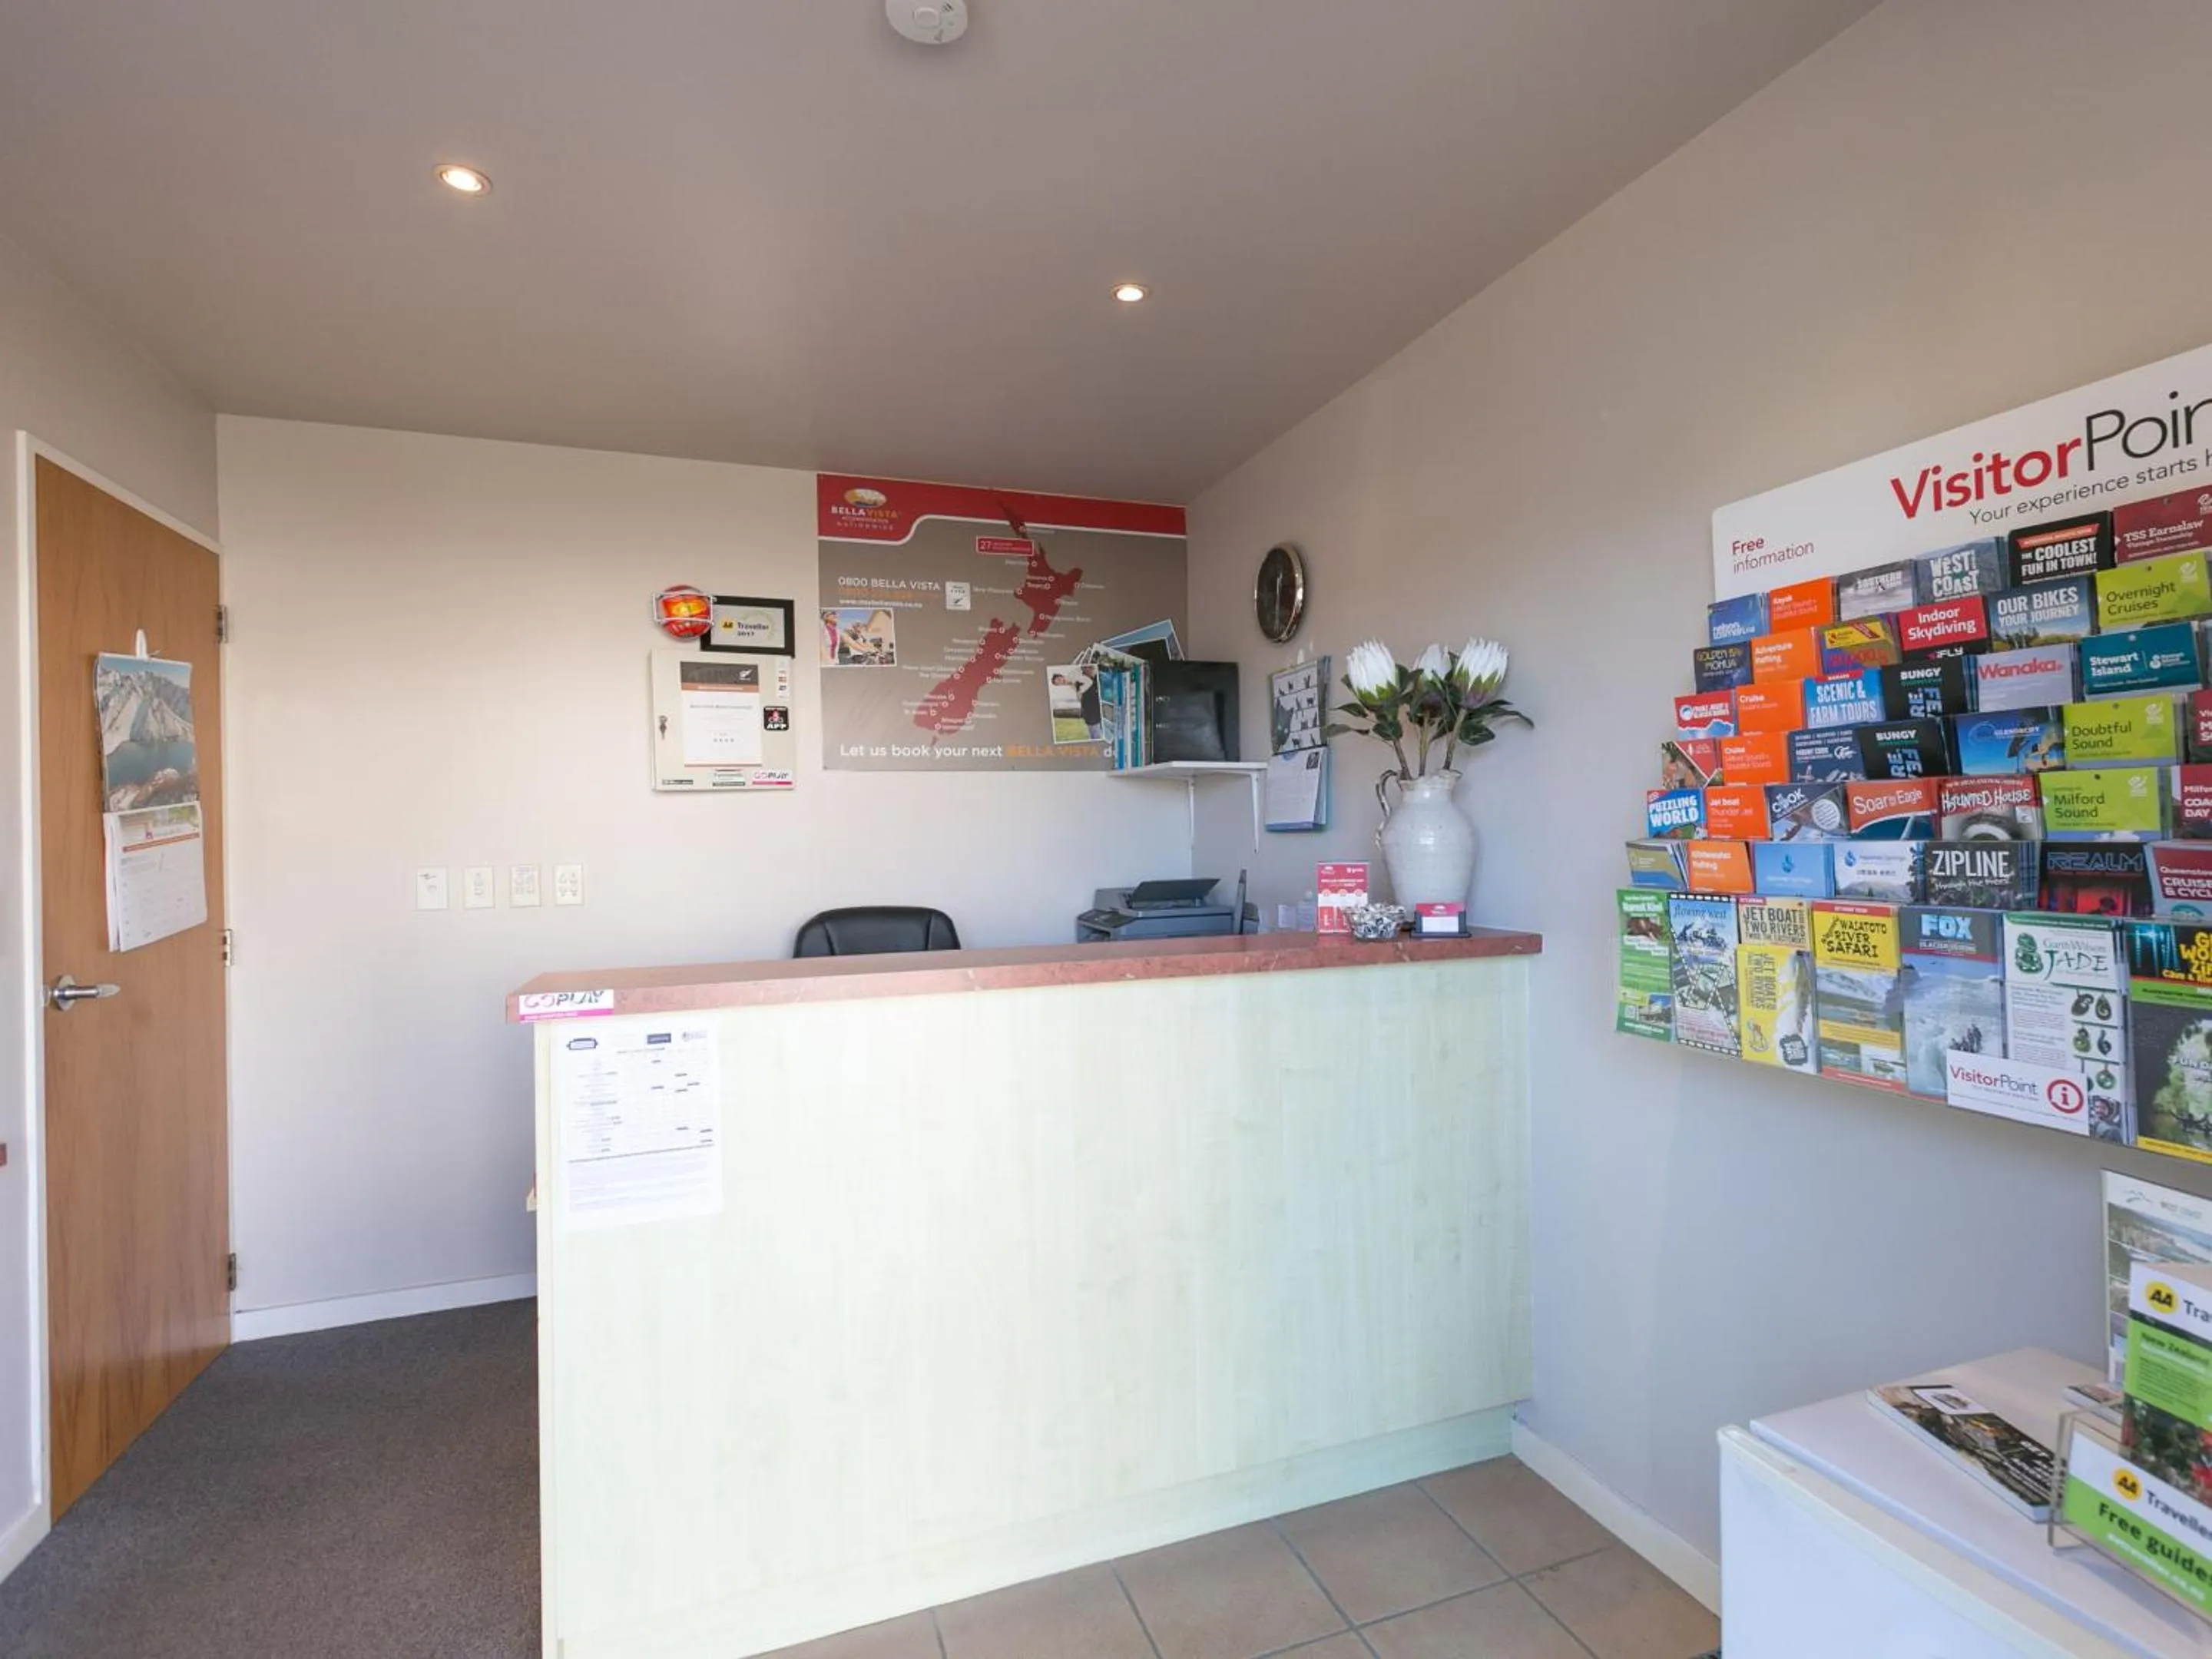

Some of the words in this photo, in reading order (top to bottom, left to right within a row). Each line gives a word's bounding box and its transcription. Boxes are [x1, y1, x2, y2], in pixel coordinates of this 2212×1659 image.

[1969, 505, 2012, 525] Your
[2016, 475, 2130, 514] experience
[2136, 459, 2198, 485] starts
[2124, 531, 2147, 542] TSS
[2149, 519, 2204, 537] Earnslaw
[1731, 536, 1765, 556] Free
[2035, 538, 2097, 561] COOLEST
[1733, 541, 1814, 574] information
[1929, 551, 1970, 577] WEST
[2021, 562, 2044, 576] FUN
[2046, 560, 2060, 572] IN
[2061, 552, 2098, 569] TOWN!
[837, 576, 868, 587] 0800
[871, 578, 906, 588] BELLA
[909, 581, 941, 591] VISTA
[1932, 570, 1979, 598] COAST
[2106, 581, 2177, 603] Overnight
[1998, 595, 2028, 615] OUR
[2032, 586, 2079, 609] BIKES
[2107, 599, 2159, 616] Cruises
[1918, 608, 1961, 624] Indoor
[1907, 620, 1977, 641] Skydiving
[1979, 657, 2058, 680] Wanaka
[2089, 652, 2139, 667] Stewart
[1900, 667, 1942, 680] BUNGY
[2091, 664, 2132, 677] Island
[1816, 681, 1855, 704] SCENIC
[1856, 680, 1866, 699] &
[1810, 704, 1839, 725] FARM
[1840, 699, 1877, 723] TOURS
[1875, 730, 1917, 741] BUNGY
[2071, 720, 2132, 737] Doubtful
[839, 743, 866, 757] Let
[869, 747, 887, 757] us
[891, 744, 929, 757] book
[935, 747, 968, 759] your
[971, 745, 1003, 757] next
[1006, 745, 1055, 757] BELLA
[1058, 745, 1098, 757] VISTA
[2071, 737, 2113, 750] Sound
[1648, 795, 1697, 815] PUZZLING
[1853, 796, 1891, 815] Soar
[2053, 792, 2105, 806] Milford
[1650, 806, 1700, 827] WORLD
[2055, 807, 2098, 819] Sound
[2184, 808, 2210, 818] DAY
[1932, 850, 2014, 879] ZIPLINE
[2047, 851, 2145, 872] REALM
[1742, 906, 1764, 922] JET
[1767, 907, 1800, 923] BOAT
[1743, 922, 1767, 934] TWO
[1769, 922, 1805, 937] RIVERS
[1840, 919, 1887, 934] WAIATOTO
[1920, 914, 1973, 940] FOX
[1834, 930, 1871, 945] RIVER
[2194, 932, 2212, 948] G
[1826, 940, 1879, 958] SAFARI
[2179, 942, 2212, 962] WO
[2043, 949, 2109, 981] JADE
[1949, 1064, 2038, 1095] VisitorPoint
[2149, 1288, 2173, 1308] AA
[2182, 1299, 2212, 1323] Tra
[2116, 1475, 2138, 1495] AA
[2098, 1502, 2143, 1541] Free
